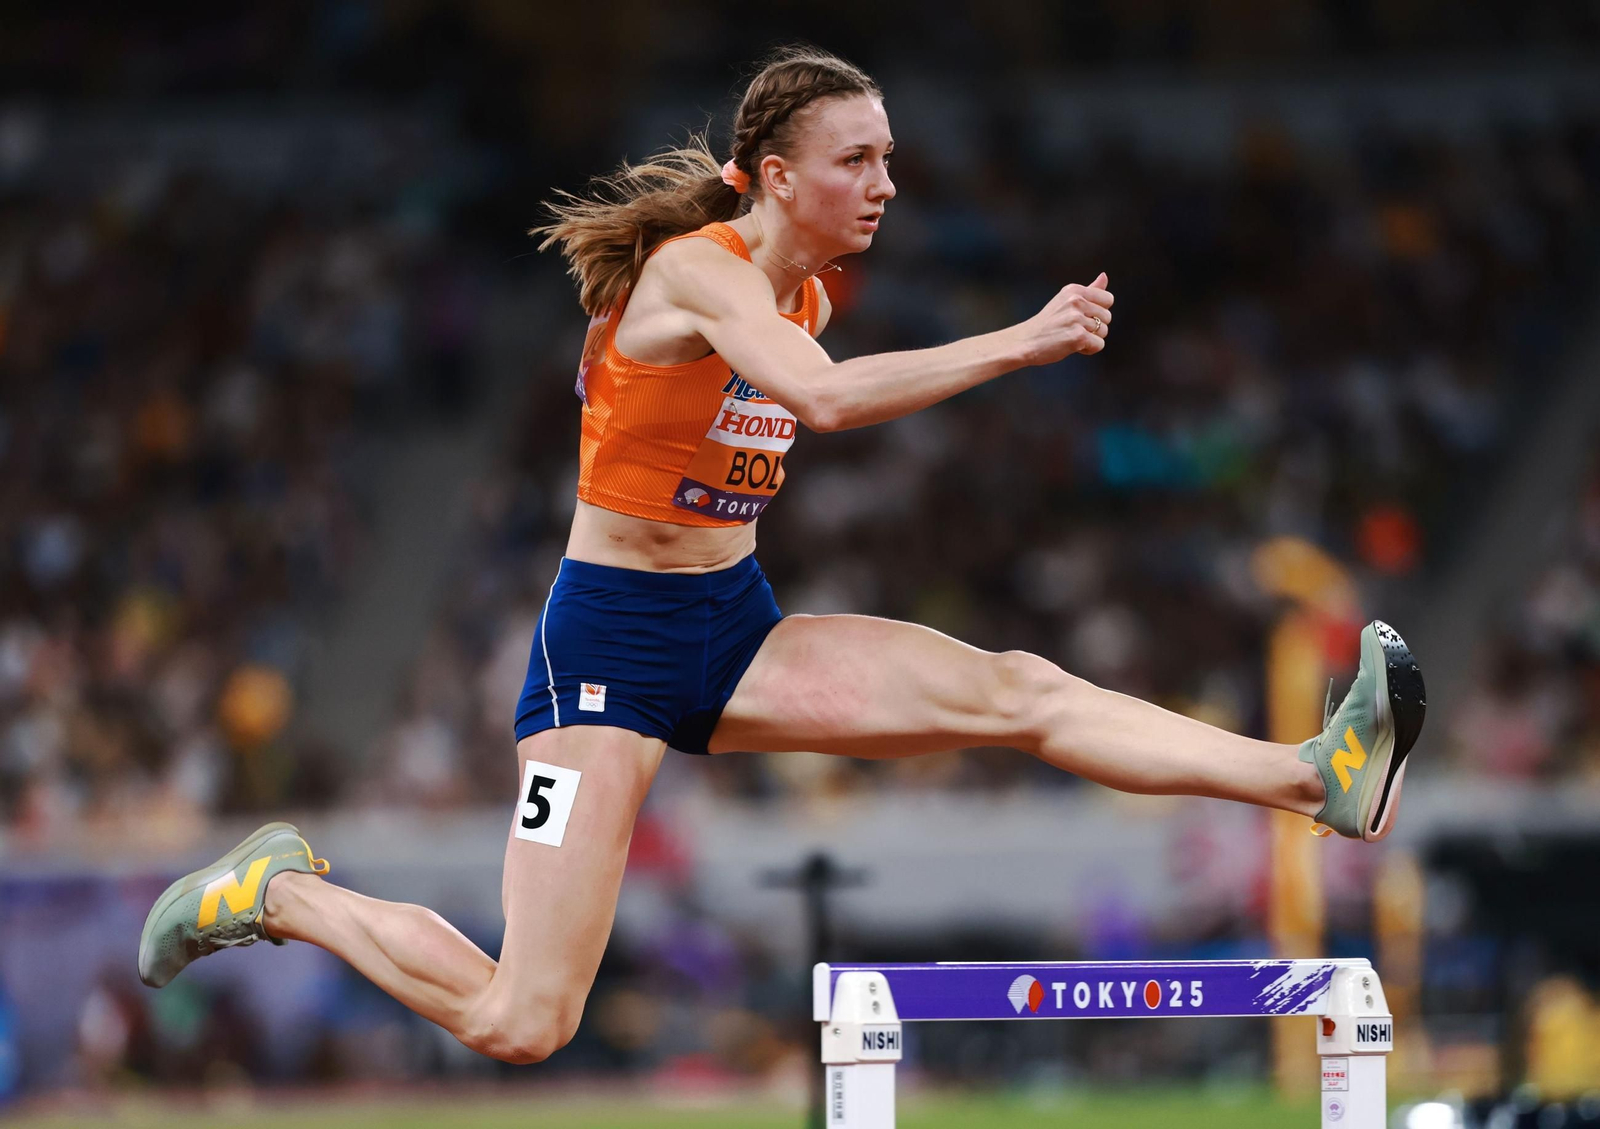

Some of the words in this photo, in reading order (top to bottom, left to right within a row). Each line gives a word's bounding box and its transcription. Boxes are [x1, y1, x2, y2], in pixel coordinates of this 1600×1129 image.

[715, 409, 796, 440] HOND
[725, 451, 781, 490] BOL
[715, 498, 768, 516] TOKY
[521, 774, 557, 830] 5
[862, 1031, 899, 1050] NISHI
[1357, 1024, 1391, 1042] NISHI
